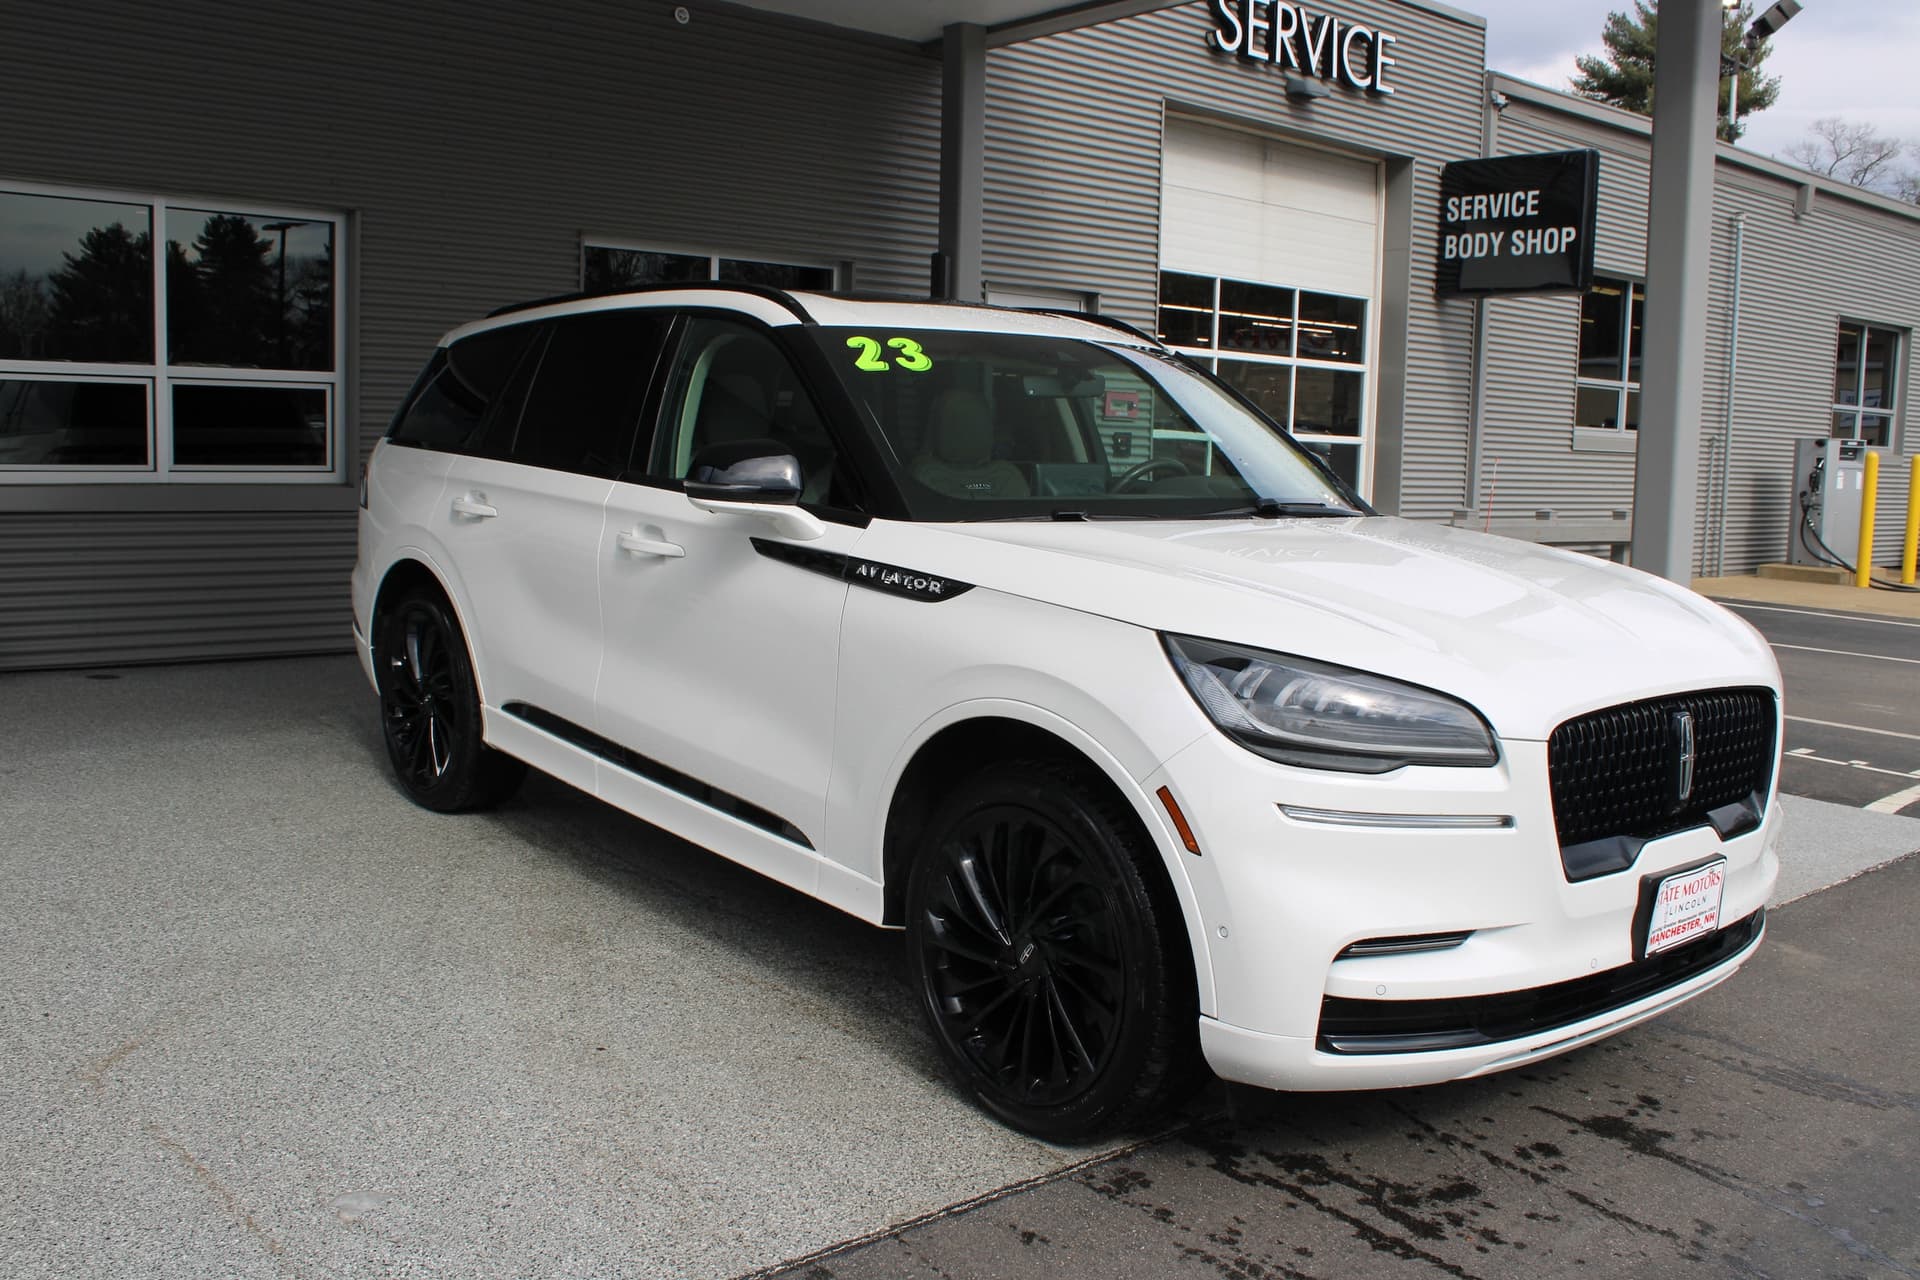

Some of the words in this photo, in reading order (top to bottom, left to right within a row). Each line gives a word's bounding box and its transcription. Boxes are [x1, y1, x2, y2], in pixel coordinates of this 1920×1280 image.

[1214, 0, 1396, 94] SERVICE
[1447, 190, 1540, 222] SERVICE
[1444, 231, 1504, 260] BODY
[1510, 227, 1577, 256] SHOP
[846, 336, 933, 372] 23
[856, 564, 943, 594] AVIATOR
[1657, 885, 1680, 905] TATE
[1683, 871, 1721, 897] MOTORS
[1669, 896, 1707, 916] LINCOLN
[1704, 912, 1715, 924] NH
